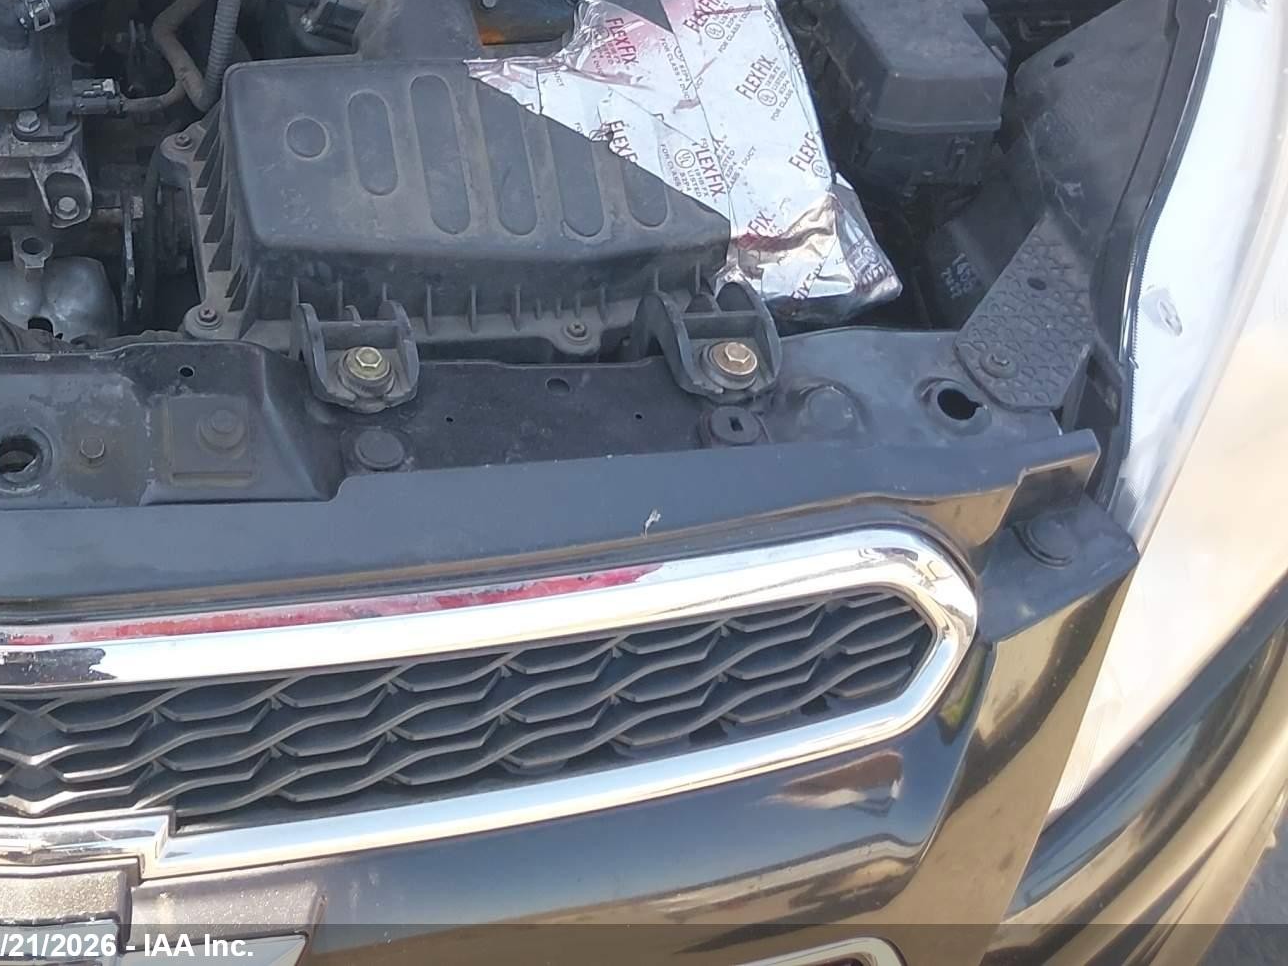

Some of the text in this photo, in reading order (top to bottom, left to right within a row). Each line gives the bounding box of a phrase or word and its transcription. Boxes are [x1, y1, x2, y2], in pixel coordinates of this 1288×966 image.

[605, 17, 639, 65] FLEXFIX
[735, 54, 775, 100] FLEXFIX
[687, 168, 702, 198] LISTED
[692, 141, 727, 198] LEXFIX
